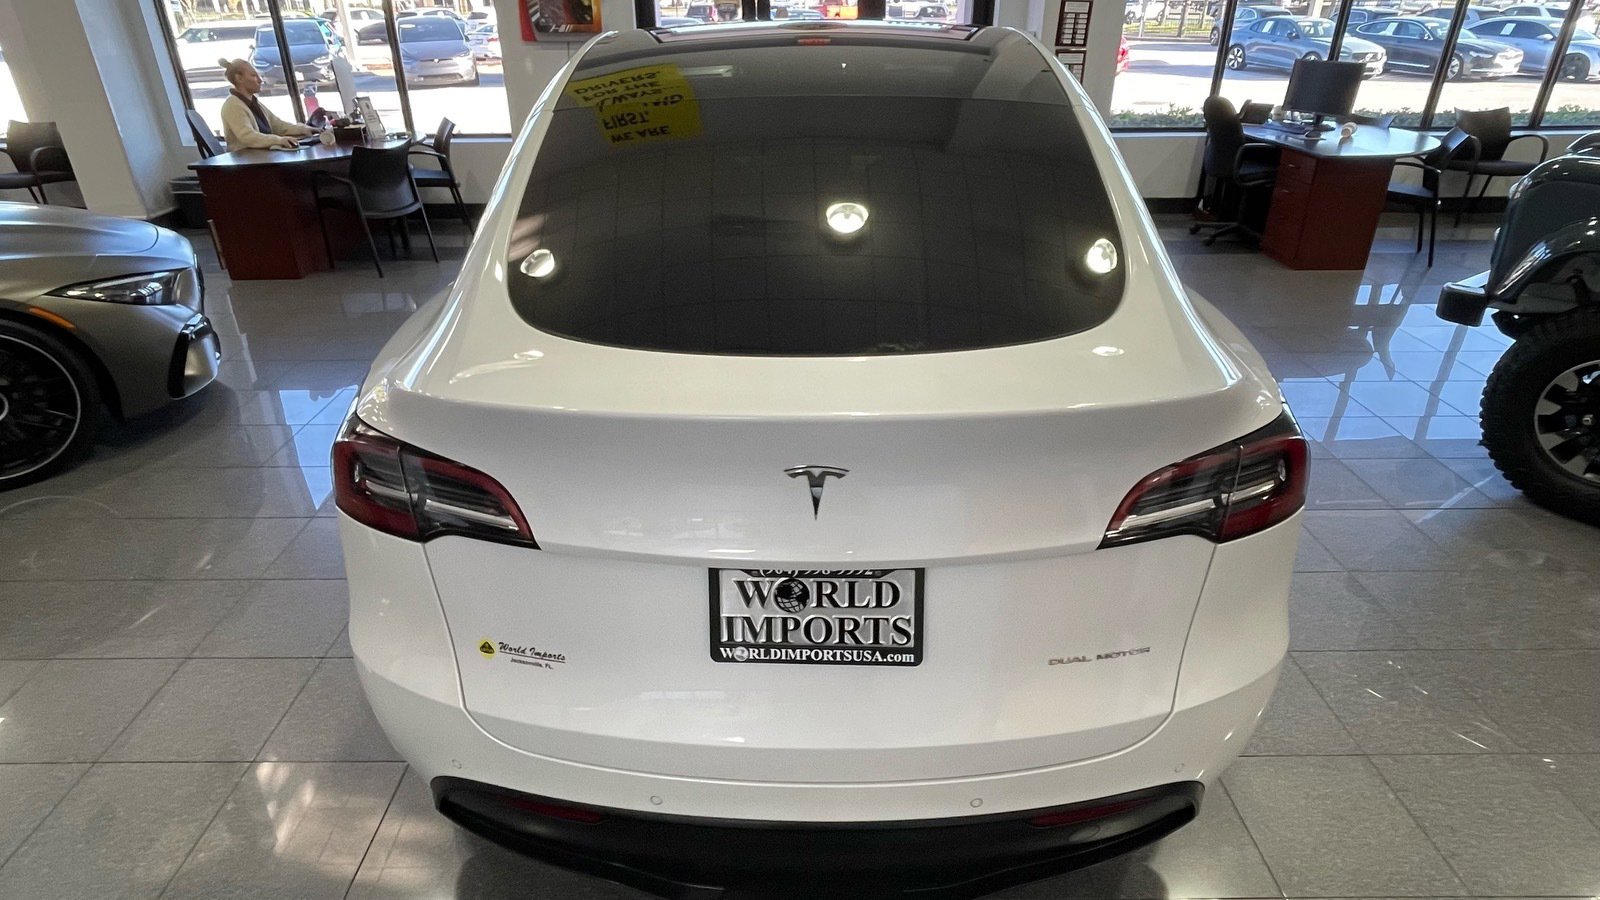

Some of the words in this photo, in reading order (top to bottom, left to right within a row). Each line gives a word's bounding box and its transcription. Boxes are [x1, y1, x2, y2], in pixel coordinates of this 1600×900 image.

[734, 577, 902, 613] WORLD
[721, 615, 913, 646] IMPORTS
[498, 641, 527, 655] World
[529, 647, 566, 661] Imports
[1048, 655, 1093, 666] DUAL
